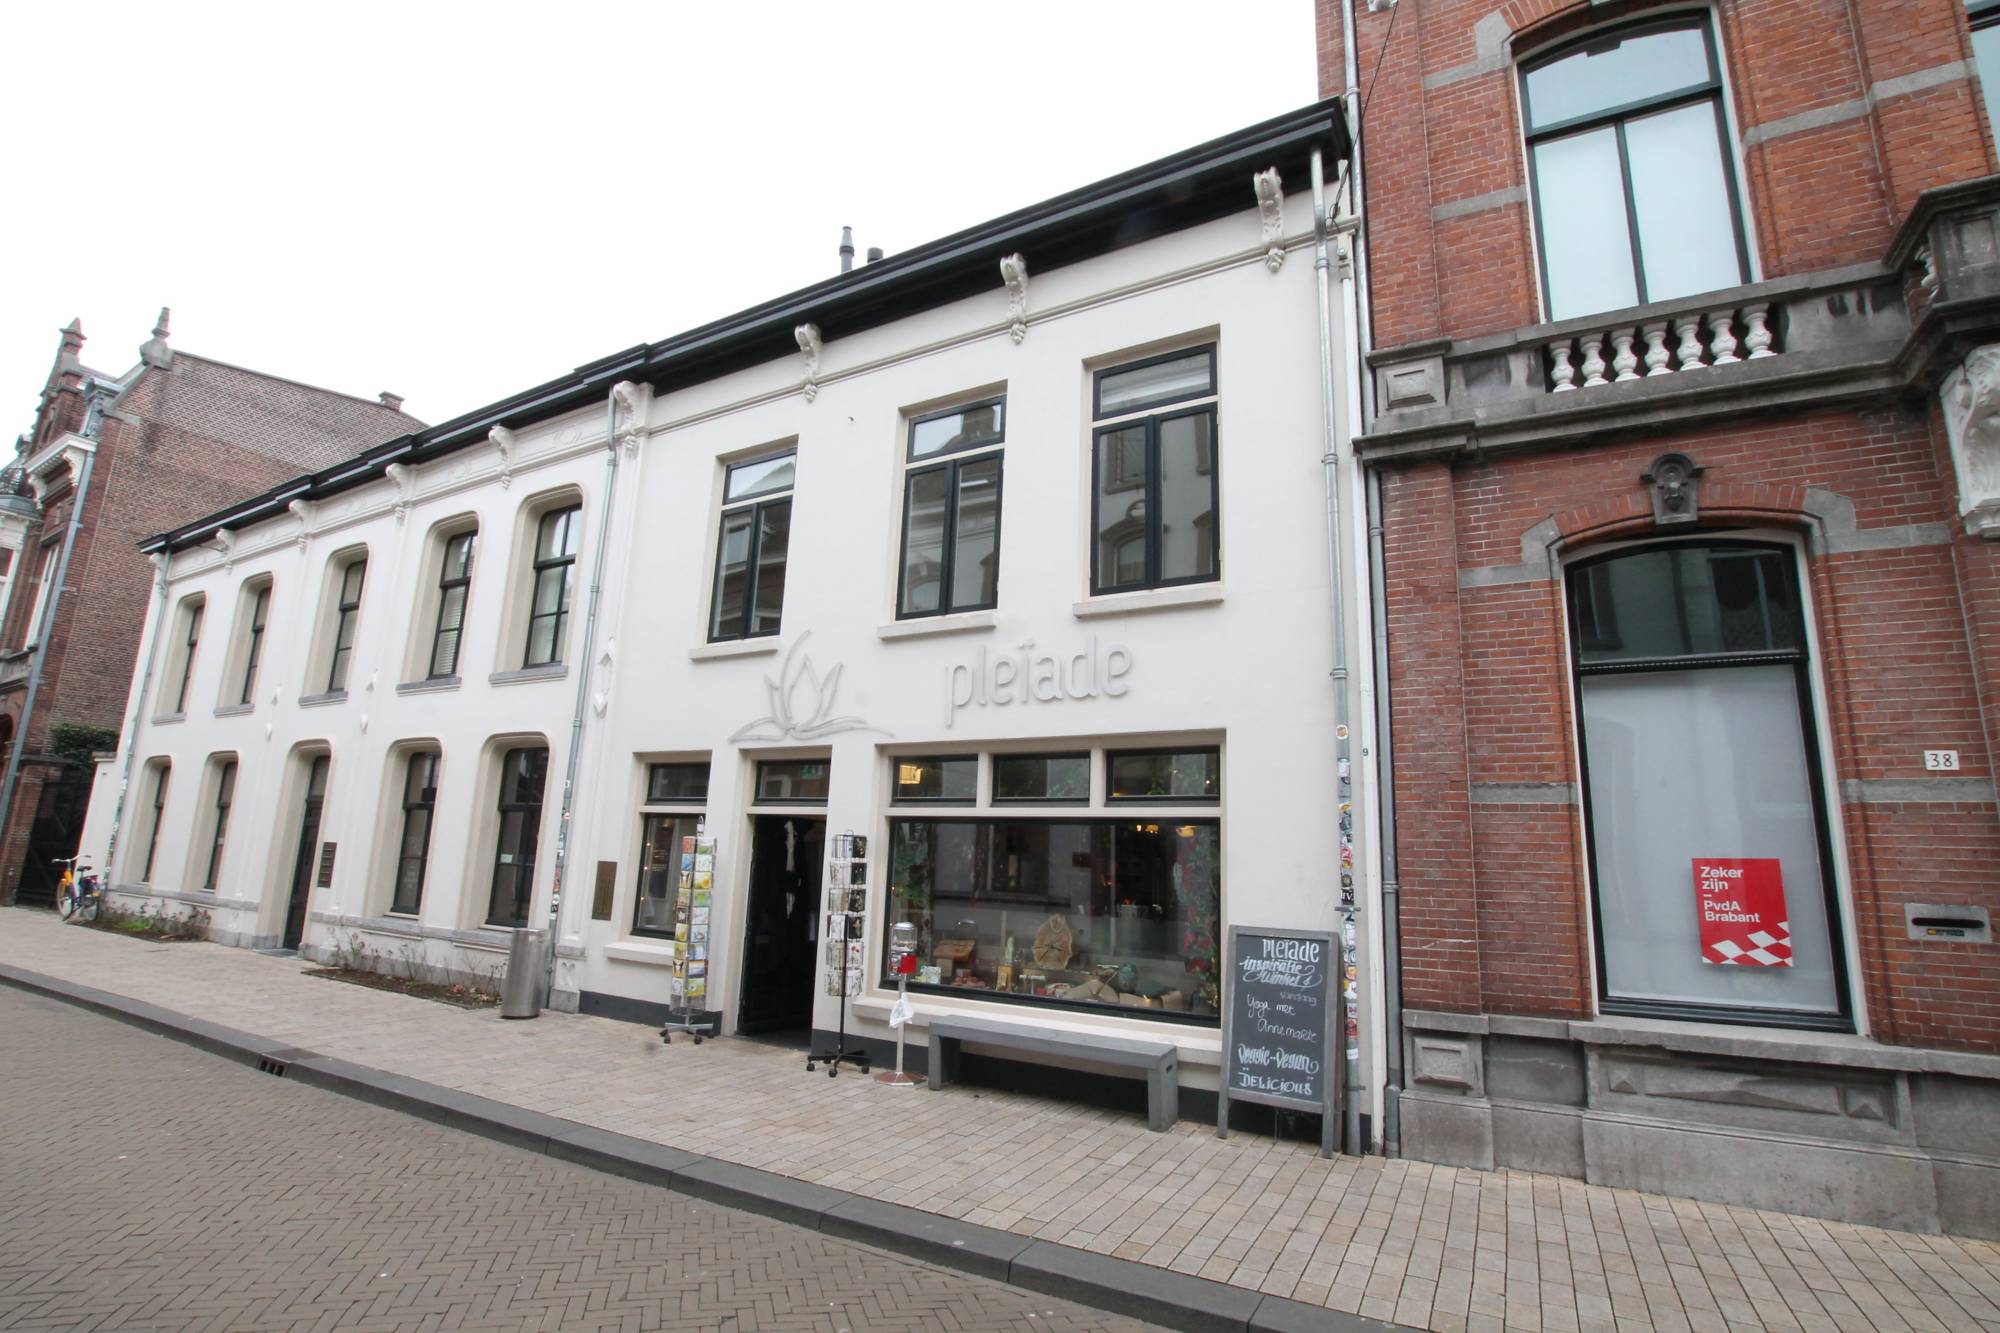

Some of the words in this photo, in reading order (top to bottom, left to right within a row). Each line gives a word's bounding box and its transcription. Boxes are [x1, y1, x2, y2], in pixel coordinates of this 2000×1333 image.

[944, 634, 1133, 728] pleïade
[1929, 753, 1953, 768] 38
[1700, 866, 1744, 879] Zeker
[1701, 878, 1729, 892] zijn
[1703, 900, 1741, 911] PvdA
[1705, 911, 1760, 923] Brabant
[1276, 1004, 1296, 1016] met
